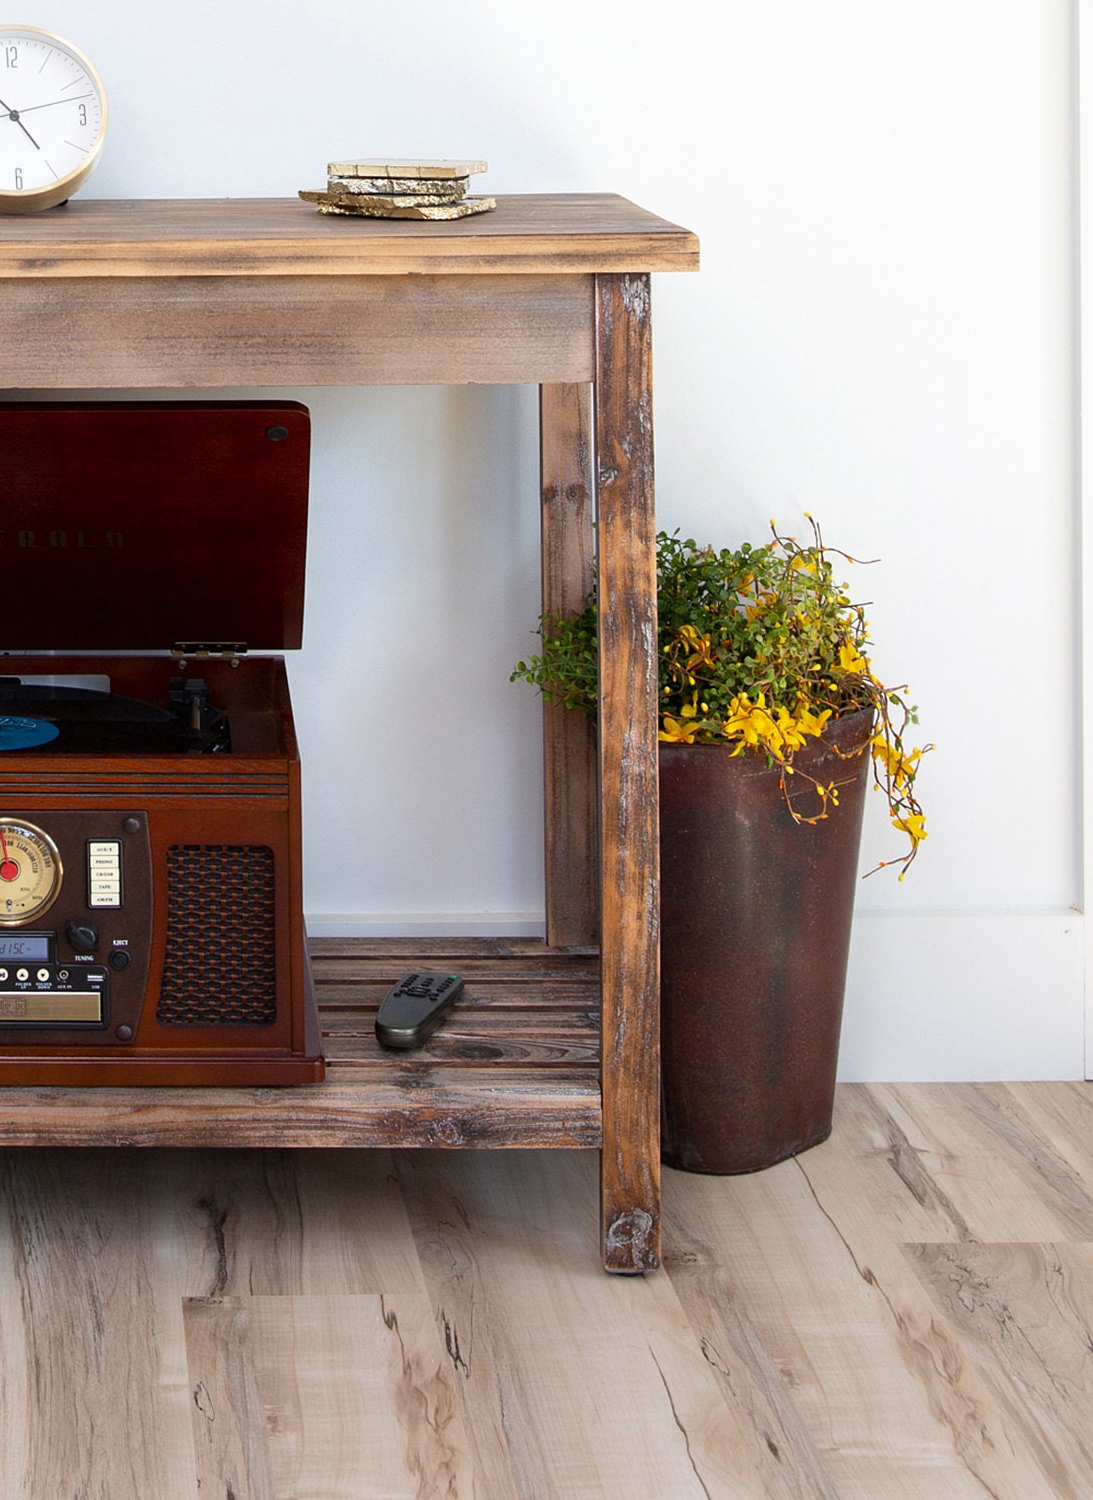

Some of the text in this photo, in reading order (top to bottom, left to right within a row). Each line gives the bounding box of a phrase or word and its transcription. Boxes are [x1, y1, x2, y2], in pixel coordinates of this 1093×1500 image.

[6, 46, 18, 68] 12
[78, 104, 87, 126] 3
[14, 168, 23, 190] 6
